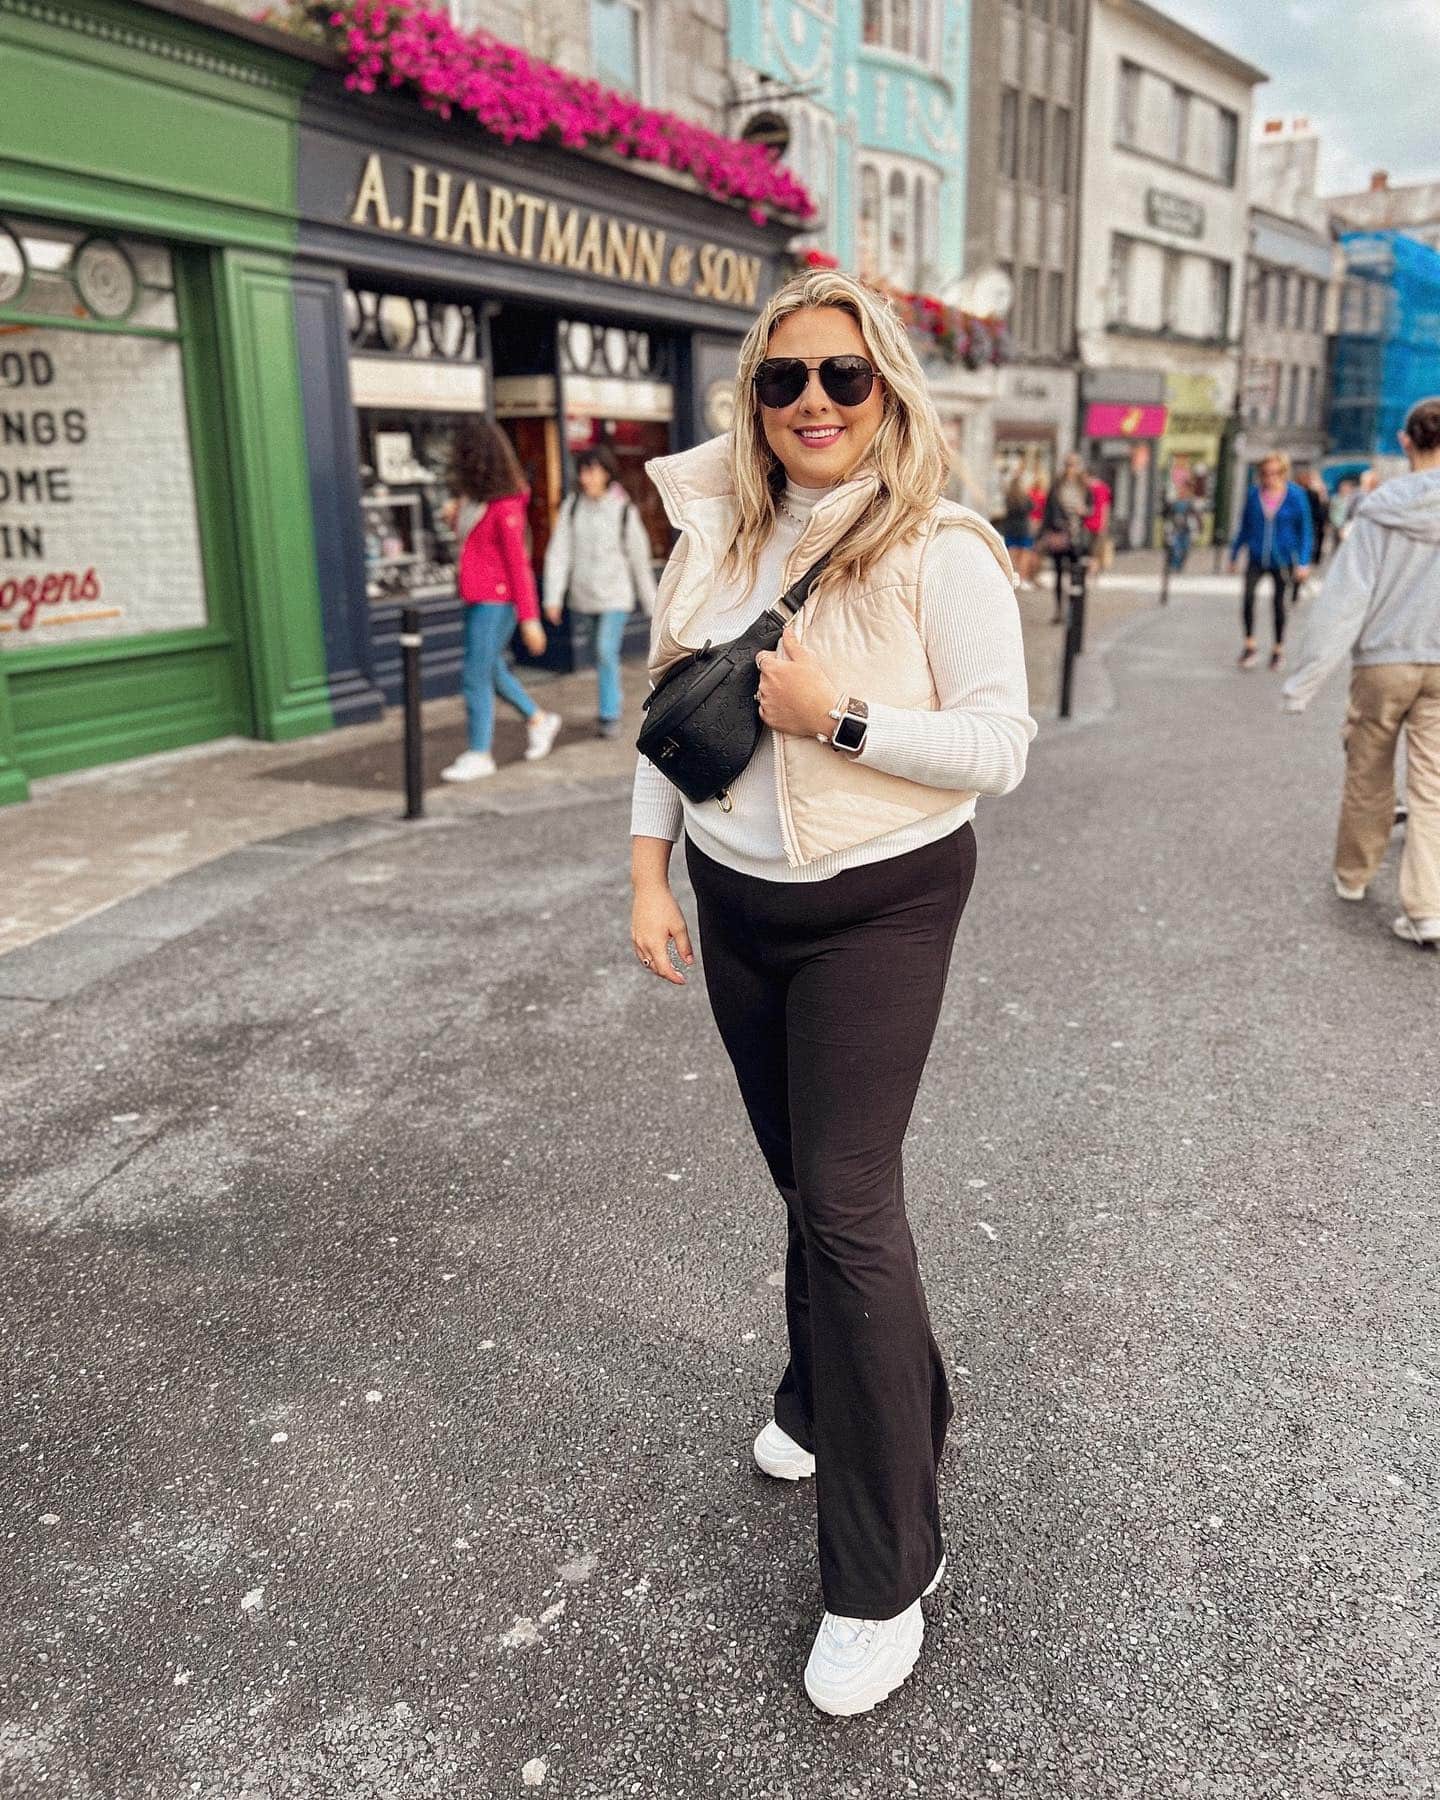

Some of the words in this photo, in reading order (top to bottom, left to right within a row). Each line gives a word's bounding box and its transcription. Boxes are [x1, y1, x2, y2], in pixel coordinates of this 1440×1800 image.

[410, 163, 667, 288] HARTMANN
[669, 246, 692, 287] &
[695, 243, 761, 306] SON
